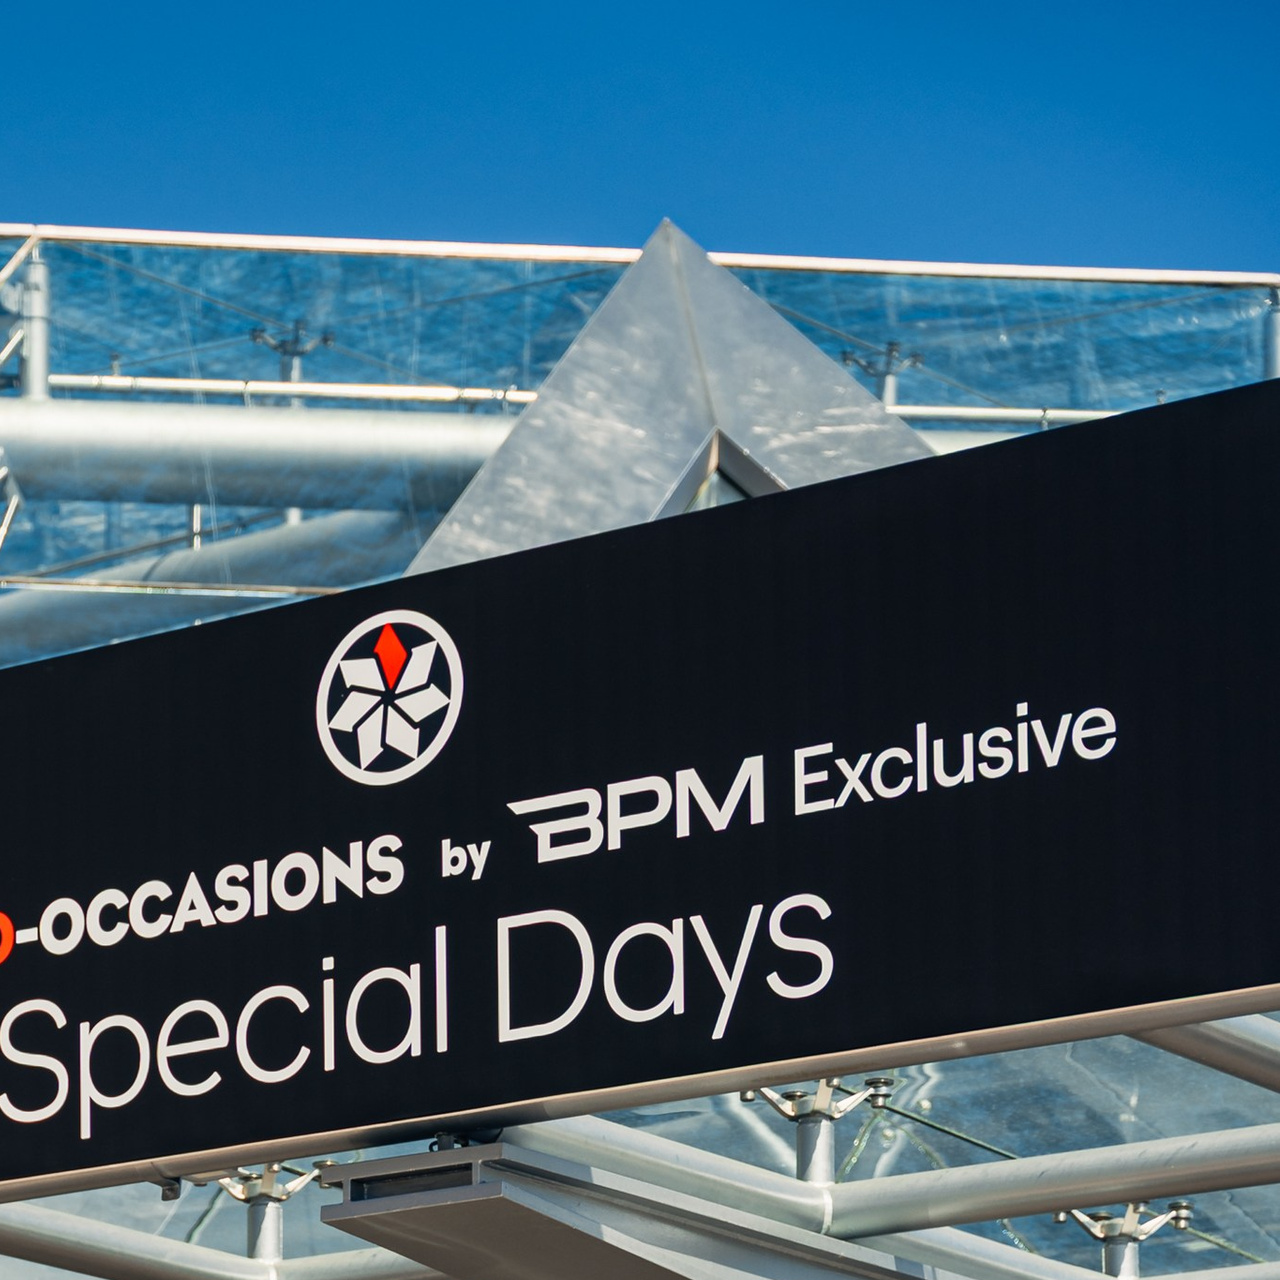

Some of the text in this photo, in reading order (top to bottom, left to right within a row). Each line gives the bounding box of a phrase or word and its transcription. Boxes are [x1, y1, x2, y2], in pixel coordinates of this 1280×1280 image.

[442, 839, 492, 881] by
[506, 754, 765, 864] BPM
[795, 701, 1117, 816] Exclusive
[497, 893, 834, 1040] Days
